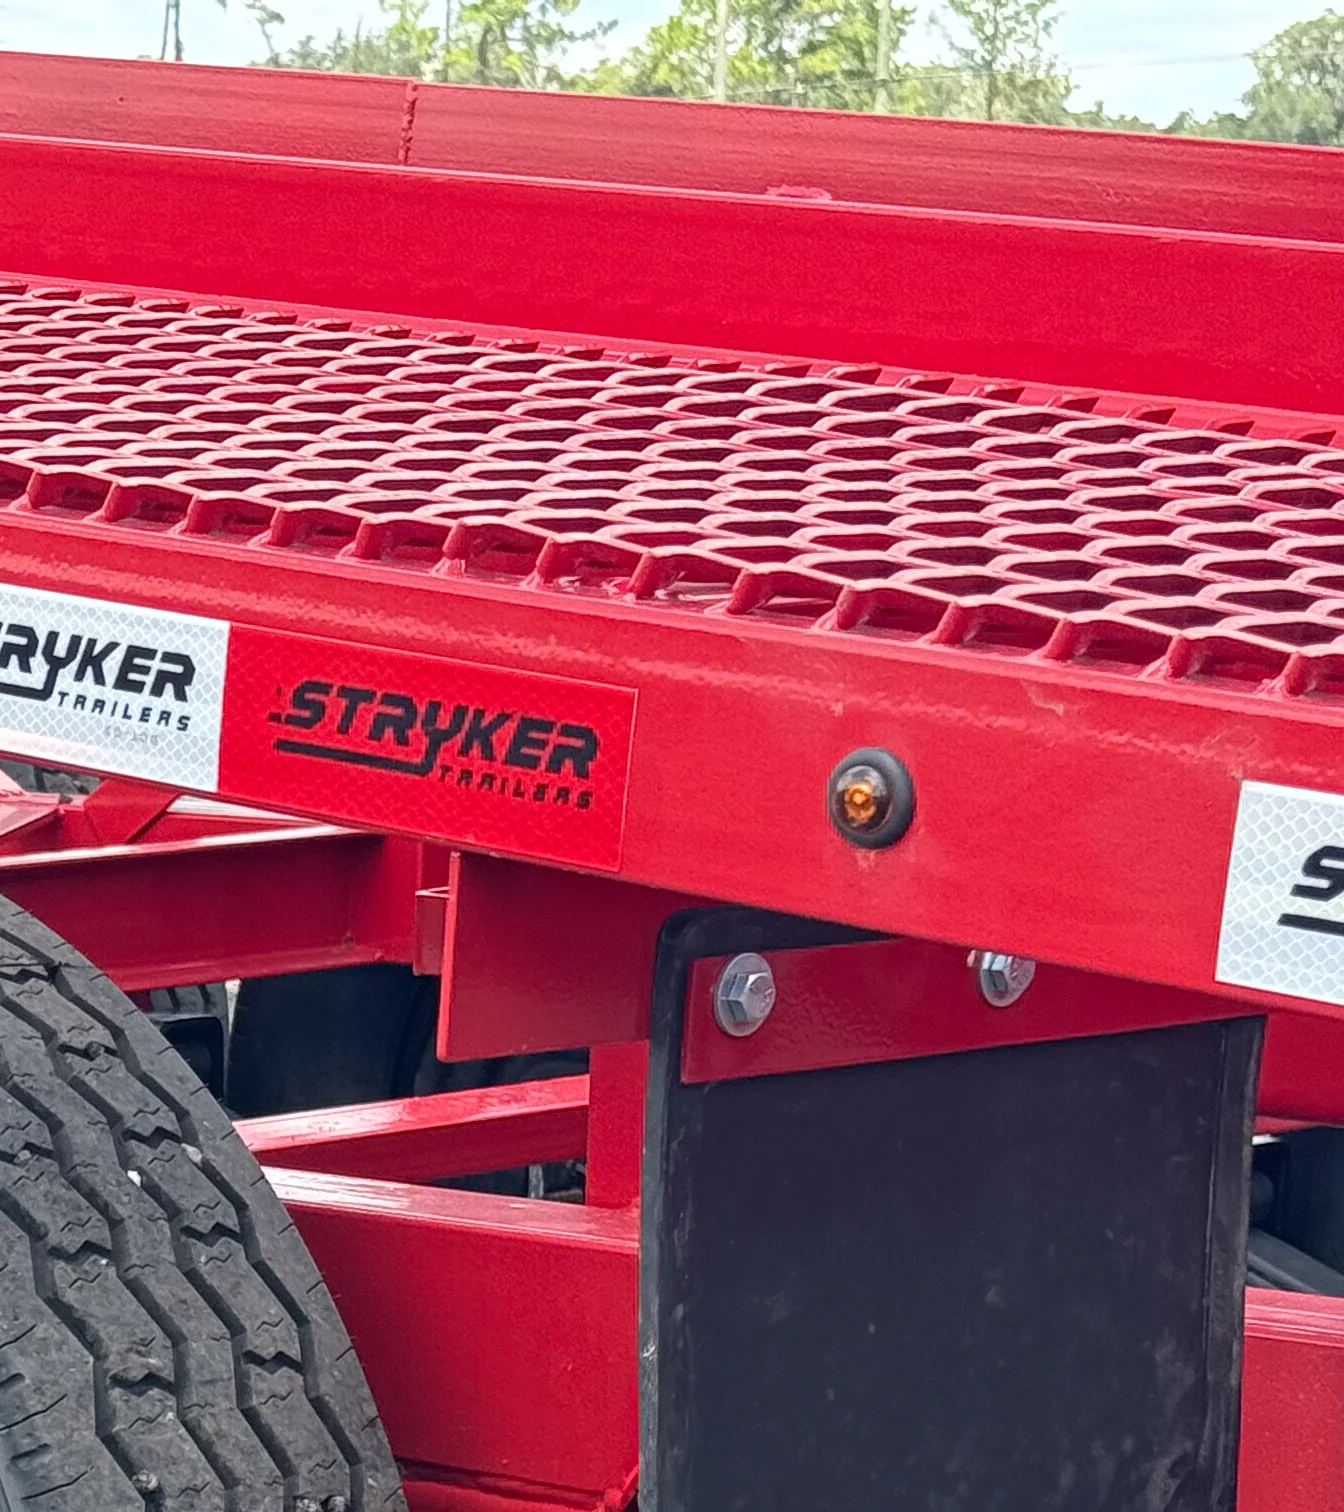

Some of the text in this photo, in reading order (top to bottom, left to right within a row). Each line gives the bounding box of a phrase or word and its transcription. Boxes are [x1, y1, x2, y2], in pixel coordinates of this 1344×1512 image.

[57, 691, 191, 732] TRAILERS
[274, 680, 599, 779] STRYKER
[440, 765, 592, 809] TRAILERS
